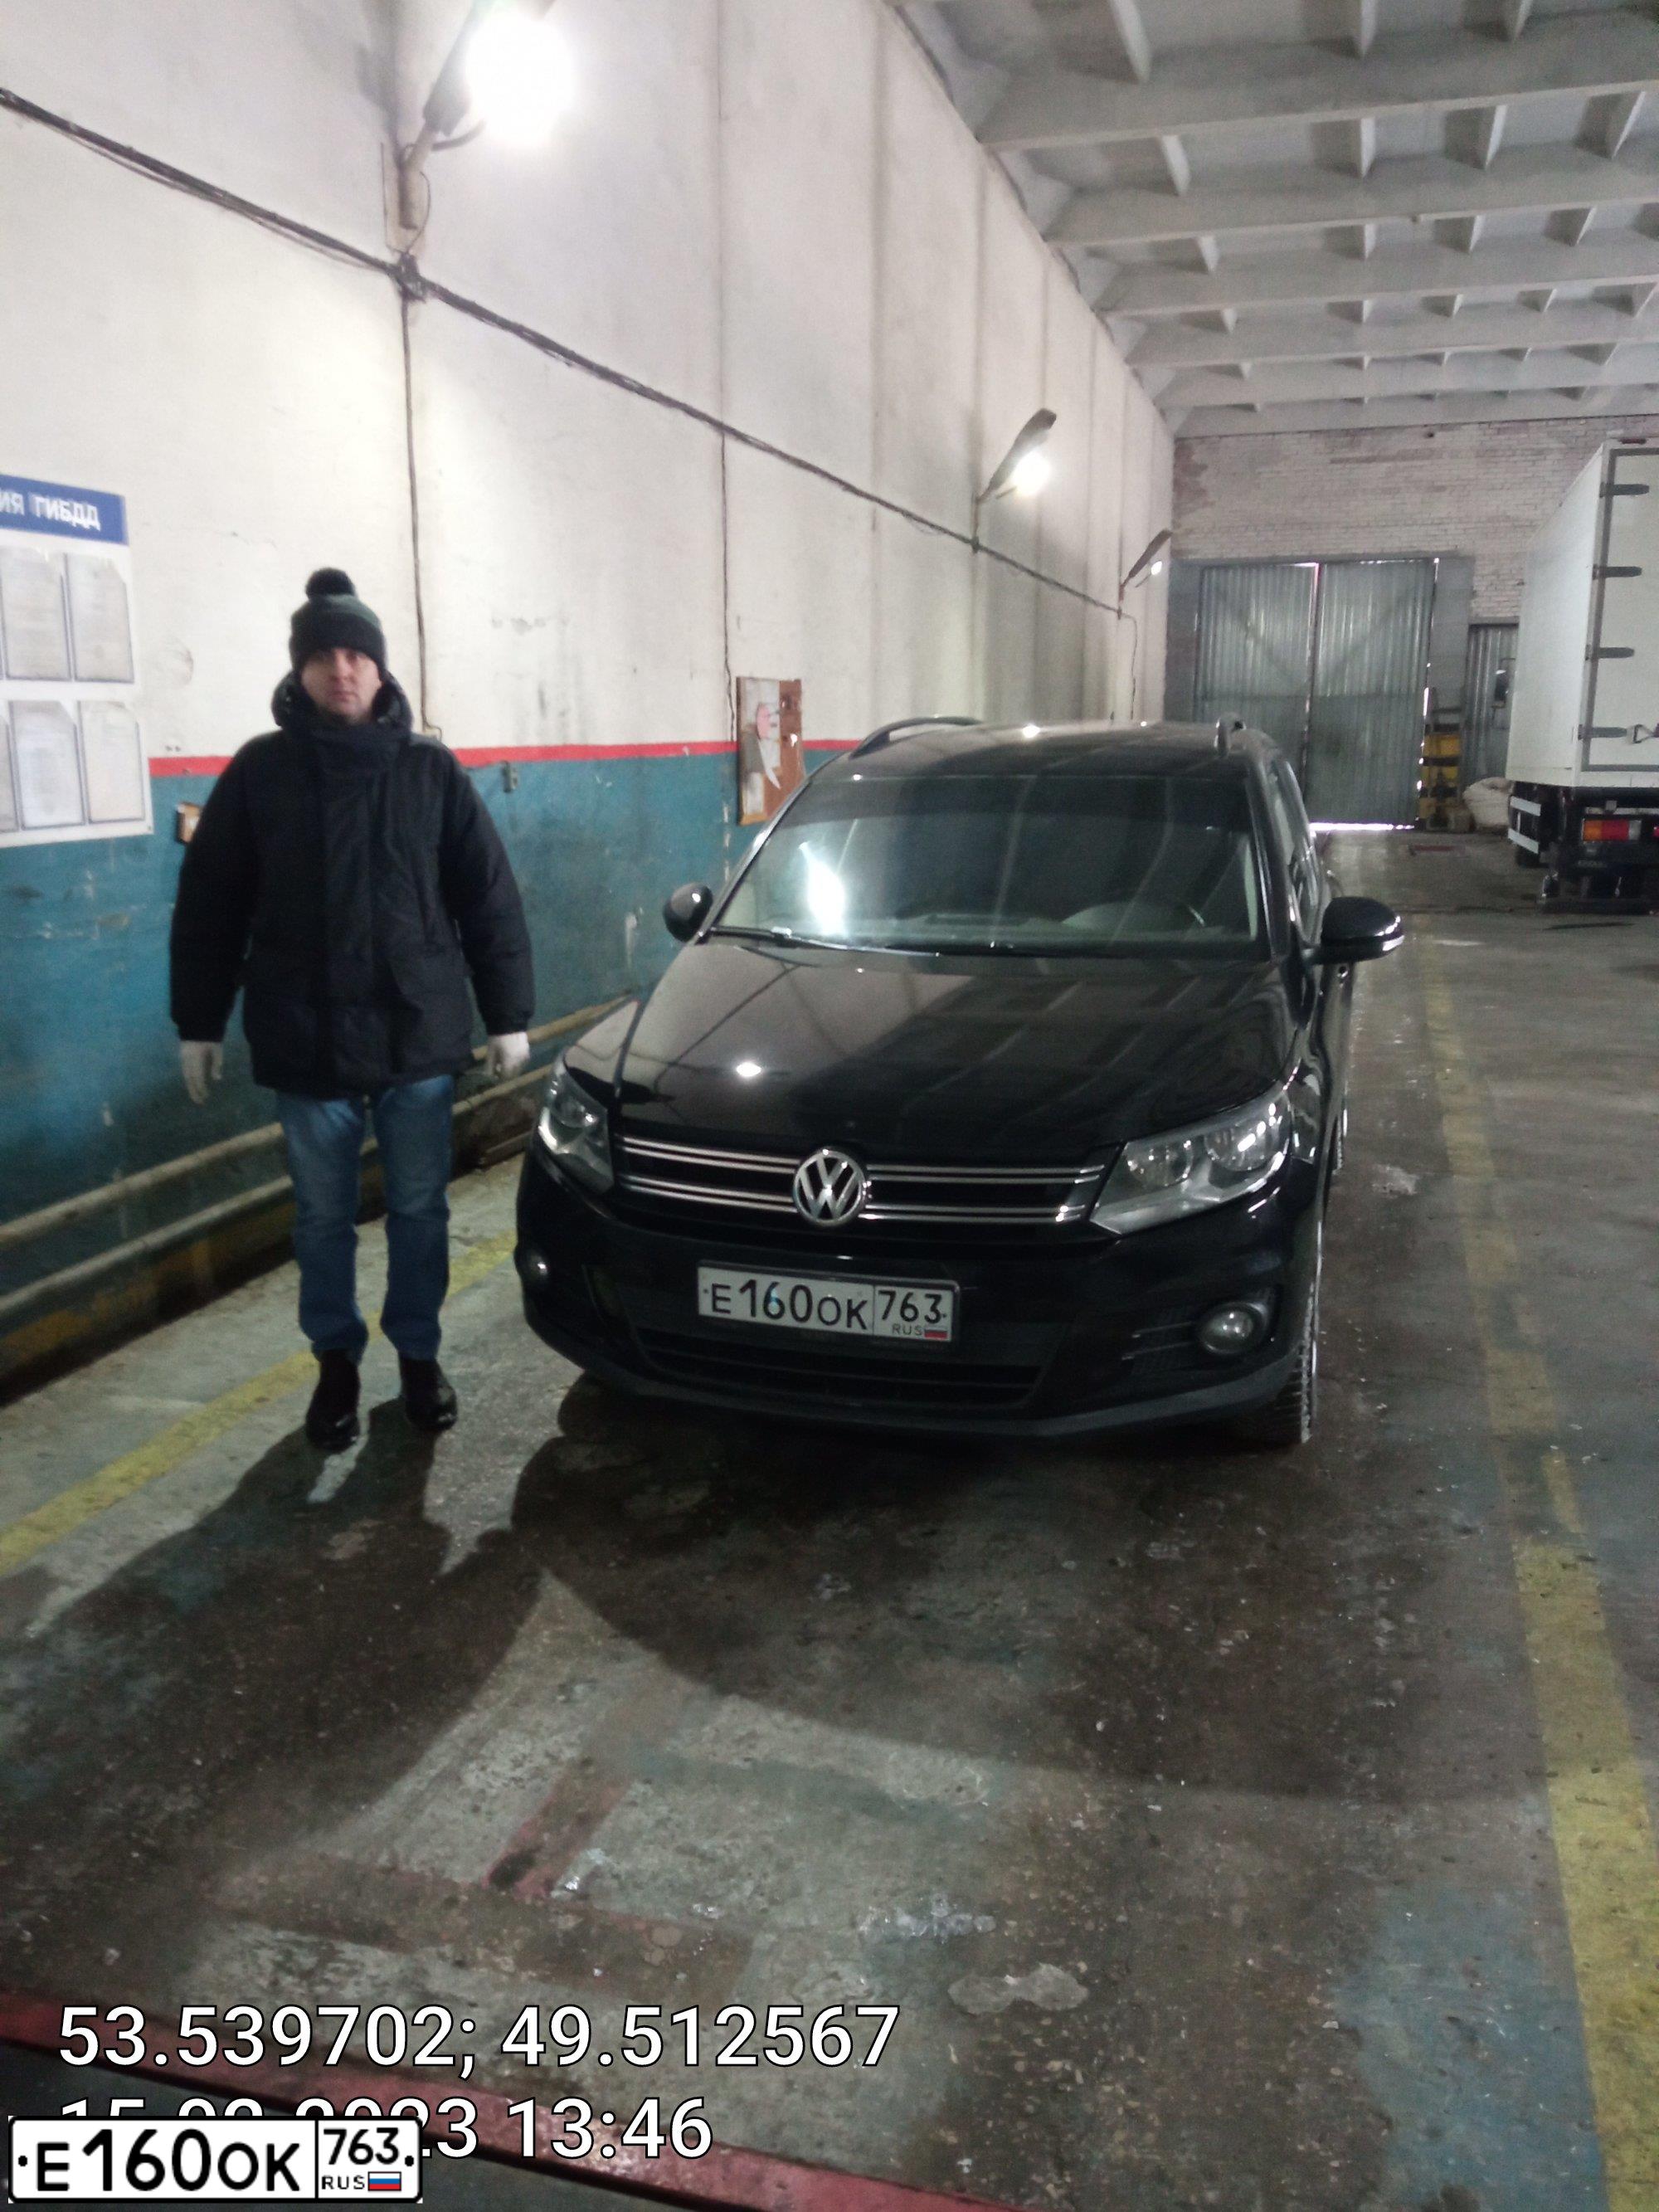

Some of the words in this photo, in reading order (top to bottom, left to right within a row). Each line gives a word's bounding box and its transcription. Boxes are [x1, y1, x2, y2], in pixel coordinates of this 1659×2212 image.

[31, 494, 101, 532] ГИБДД
[878, 1289, 943, 1325] 763
[891, 1323, 923, 1337] RUS
